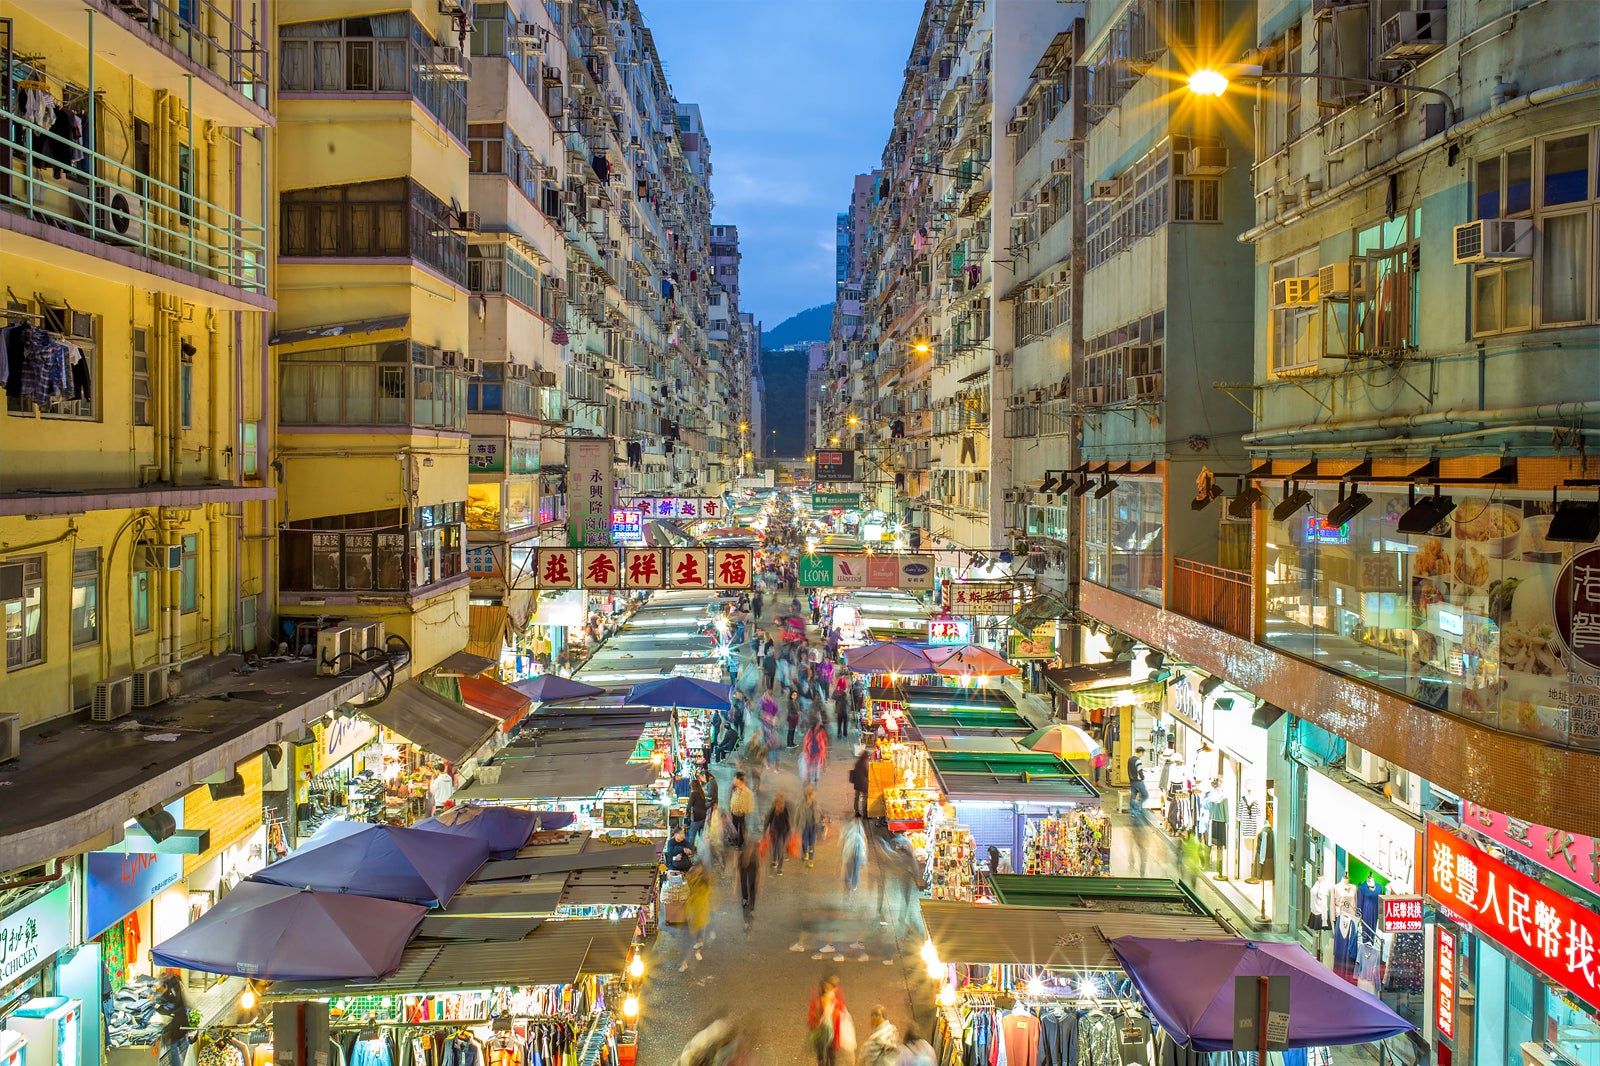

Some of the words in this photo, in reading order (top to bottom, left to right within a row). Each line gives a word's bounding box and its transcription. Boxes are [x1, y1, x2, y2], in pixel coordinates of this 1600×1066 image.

[590, 469, 603, 514] 永興隆
[1432, 840, 1600, 988] 港豐人民幣找
